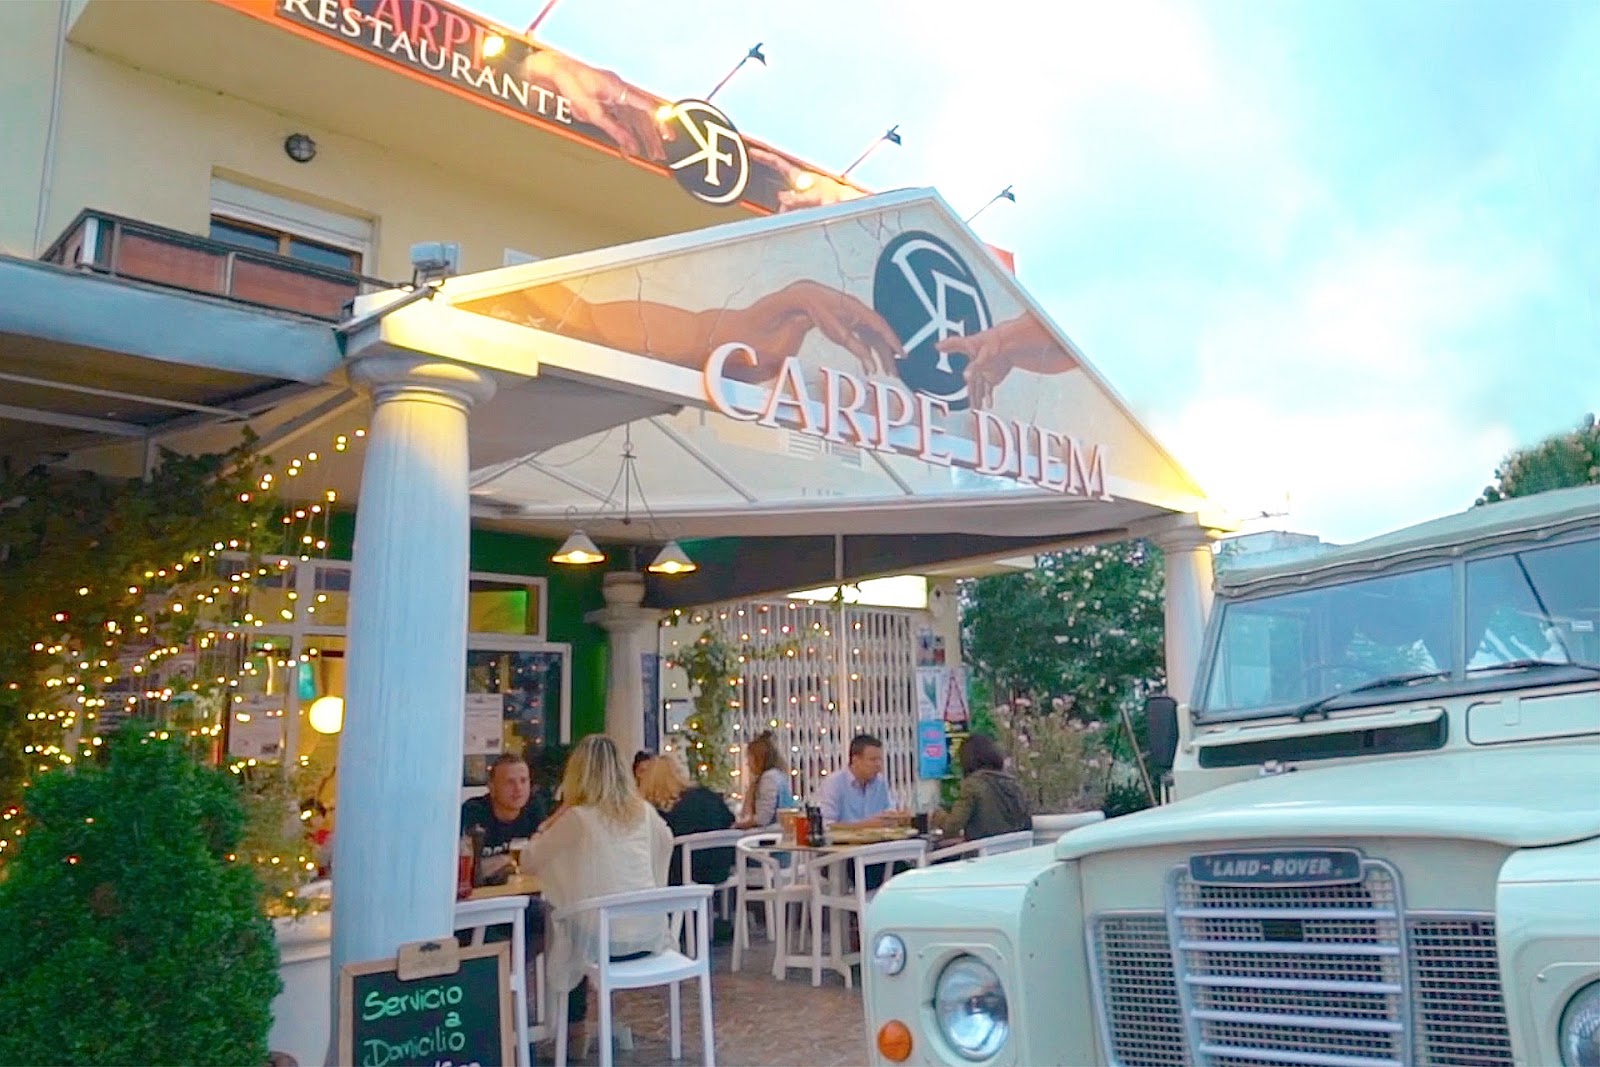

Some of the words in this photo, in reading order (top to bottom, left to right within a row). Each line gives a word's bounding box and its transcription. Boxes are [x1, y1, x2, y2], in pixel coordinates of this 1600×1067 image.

[283, 0, 572, 124] RESTAURANTE
[704, 342, 952, 467] CARPE
[973, 408, 1114, 502] DIEM
[1212, 857, 1332, 877] LAND-ROVER
[362, 985, 463, 1021] Servicio
[444, 1011, 462, 1027] a
[362, 1026, 466, 1067] Domicilio
